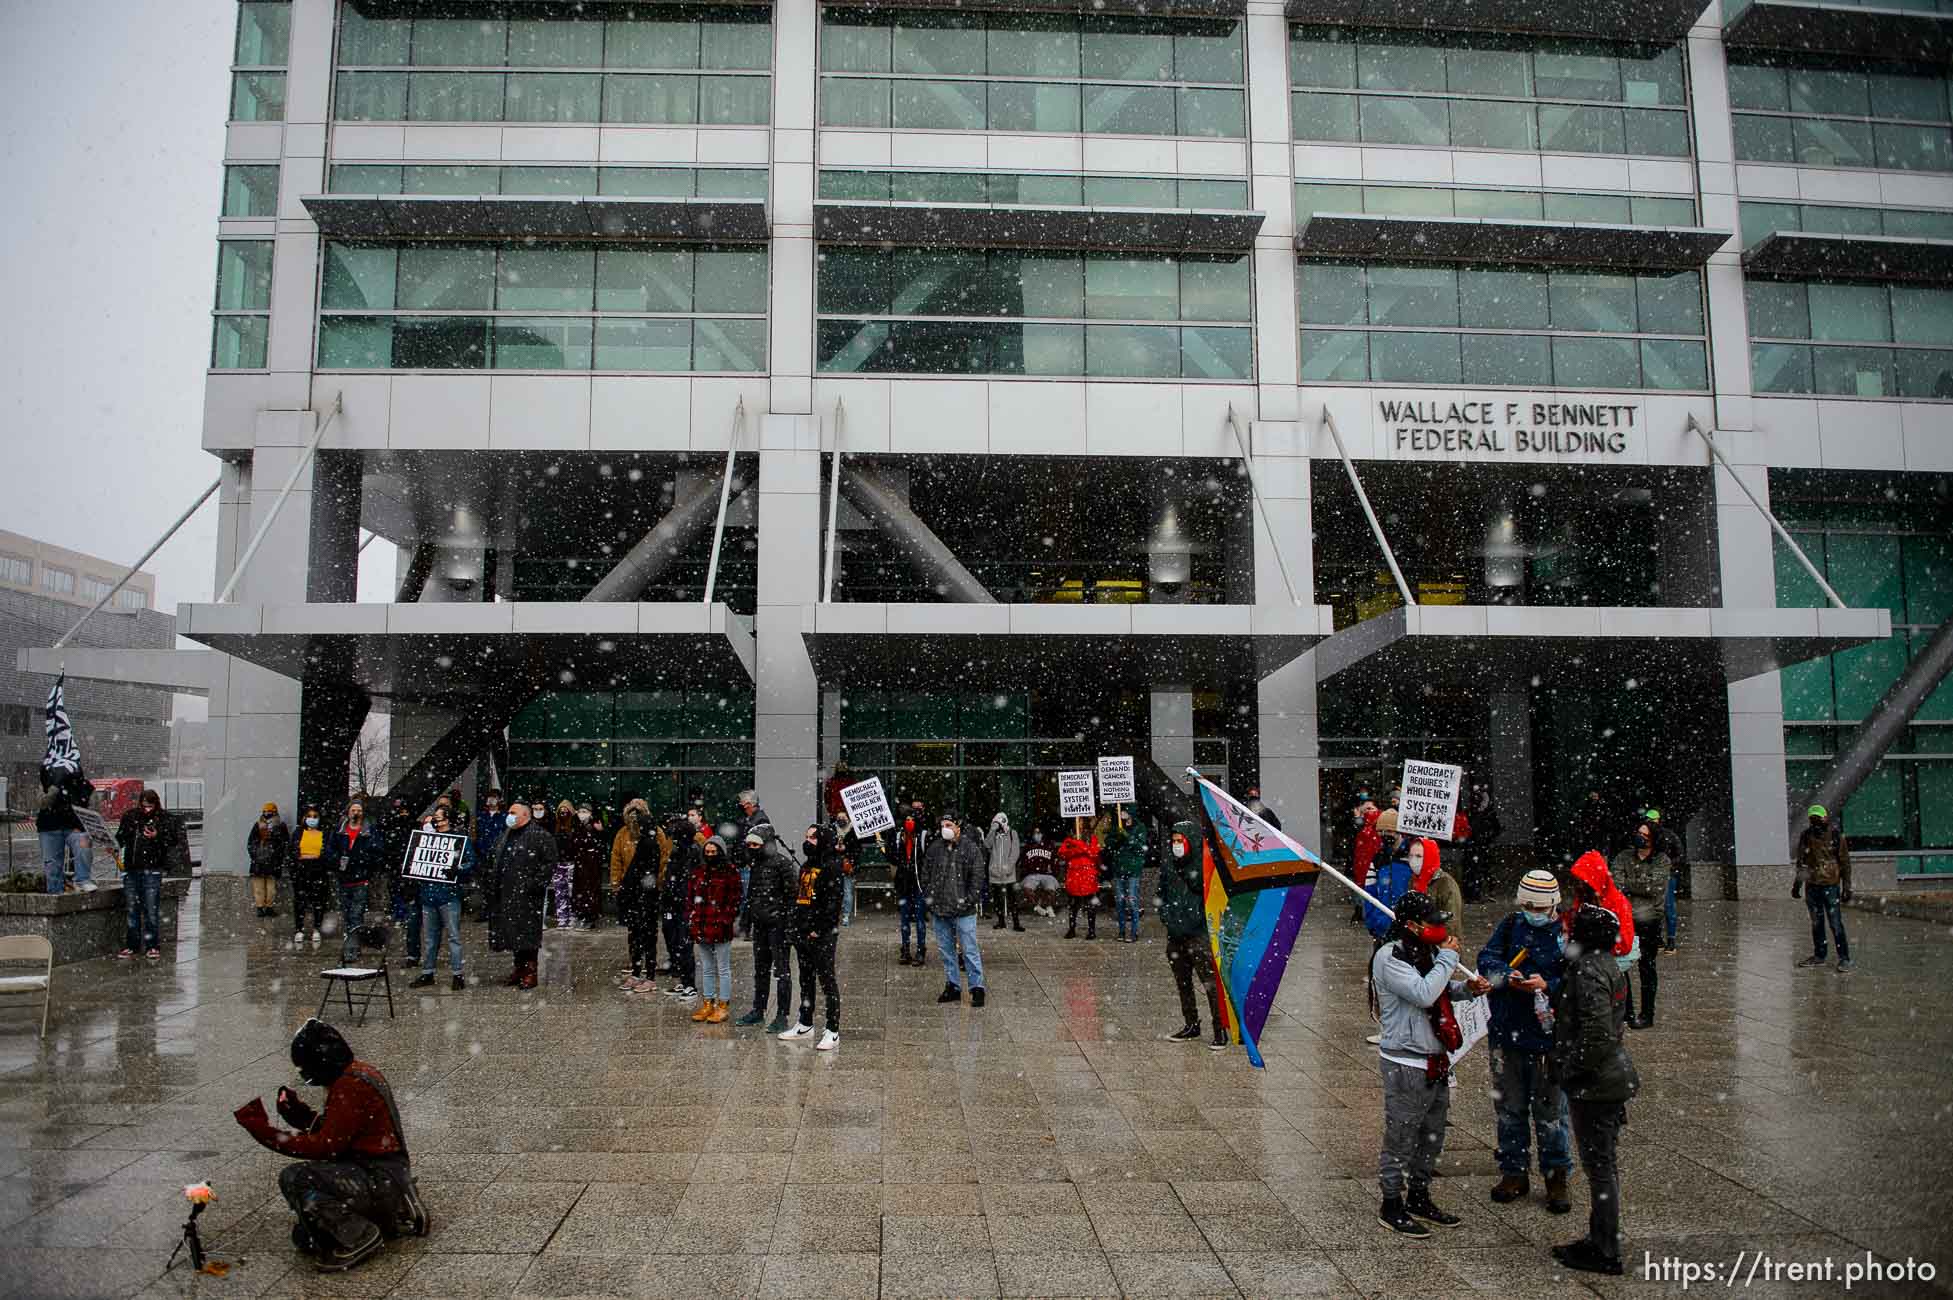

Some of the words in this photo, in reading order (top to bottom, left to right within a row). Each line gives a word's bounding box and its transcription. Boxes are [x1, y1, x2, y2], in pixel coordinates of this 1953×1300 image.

[1379, 401, 1493, 424] WALLACE
[1506, 403, 1520, 425] F.
[1532, 403, 1637, 427] BENNETT
[1395, 428, 1504, 452] FEDERAL
[1515, 430, 1626, 454] BUILDING
[1060, 773, 1089, 781] DEMOCRACY
[1407, 764, 1455, 779] DEMOCRACY
[844, 781, 877, 798] DEMOCRACY
[1410, 776, 1442, 788] REQUIRES
[1406, 785, 1432, 798] WHOLE
[1433, 789, 1451, 800] NEW
[850, 799, 869, 811] WHOLE
[869, 795, 882, 805] NEW
[1406, 799, 1448, 816] SYSTEM!
[419, 834, 457, 851] BLACK
[418, 848, 450, 864] LIVES
